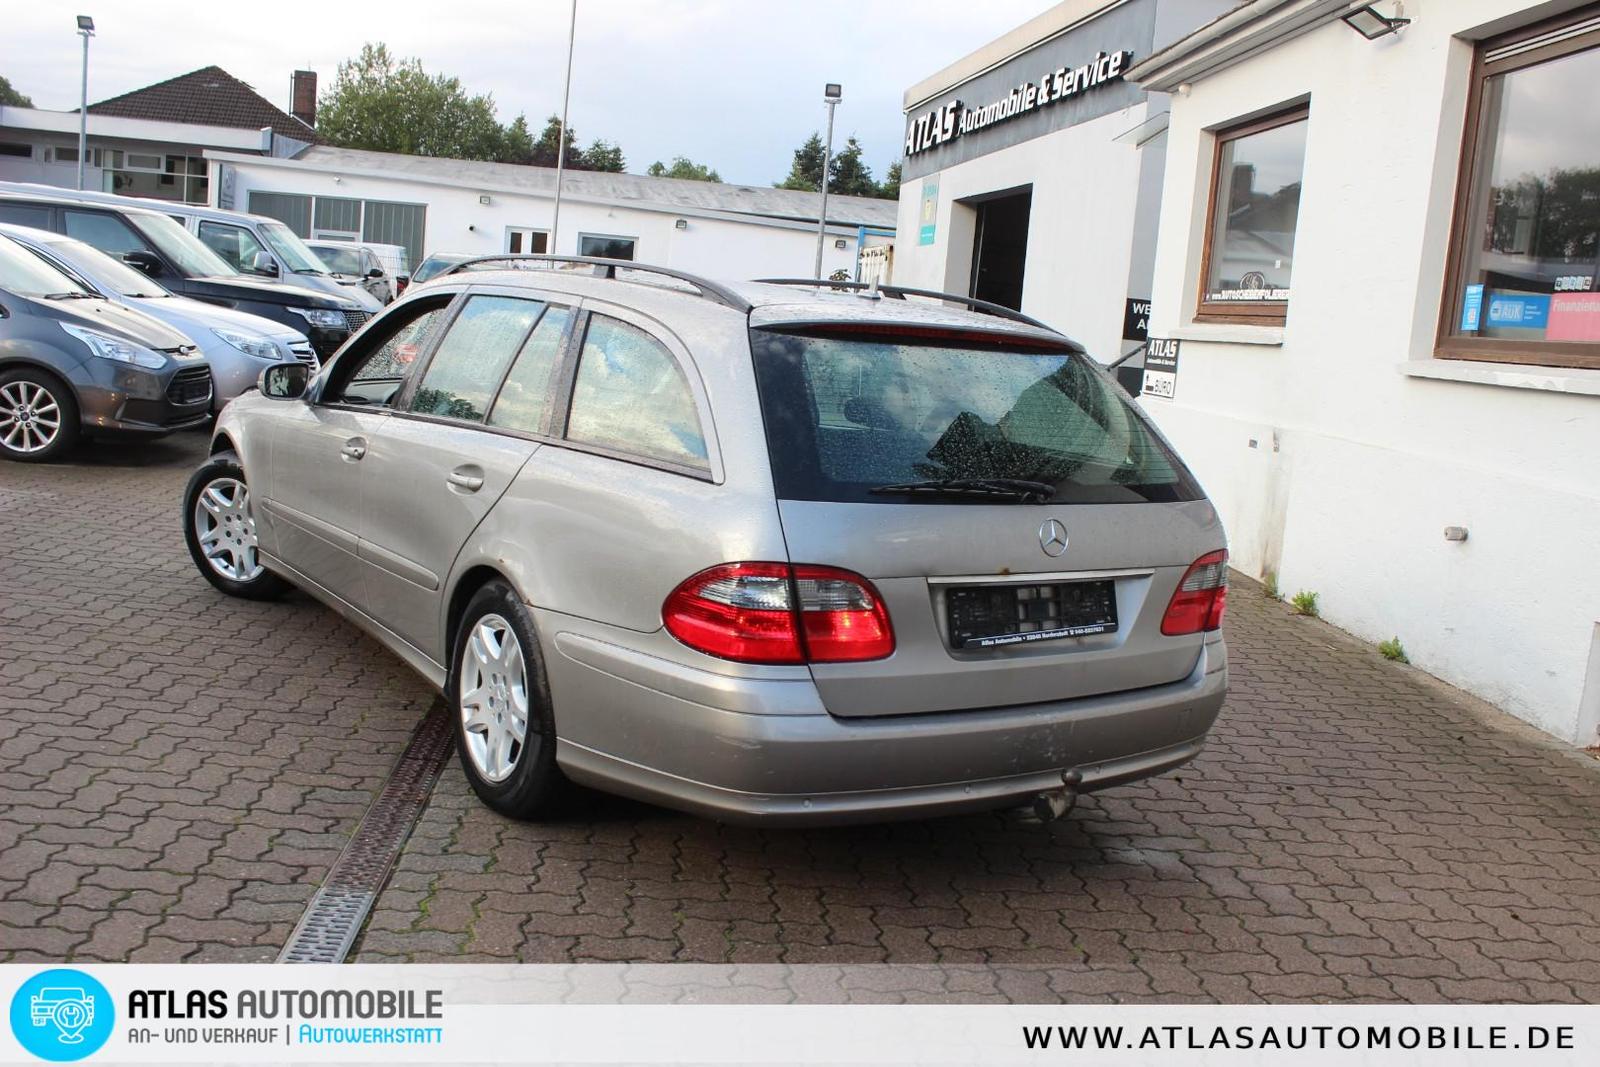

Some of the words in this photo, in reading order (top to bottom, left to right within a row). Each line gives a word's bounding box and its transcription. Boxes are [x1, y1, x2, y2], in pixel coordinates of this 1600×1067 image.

[905, 100, 959, 155] ATLAS
[958, 83, 1036, 135] Automobile
[1037, 76, 1050, 105] &
[1052, 50, 1126, 101] Service
[1147, 340, 1178, 357] ATLAS
